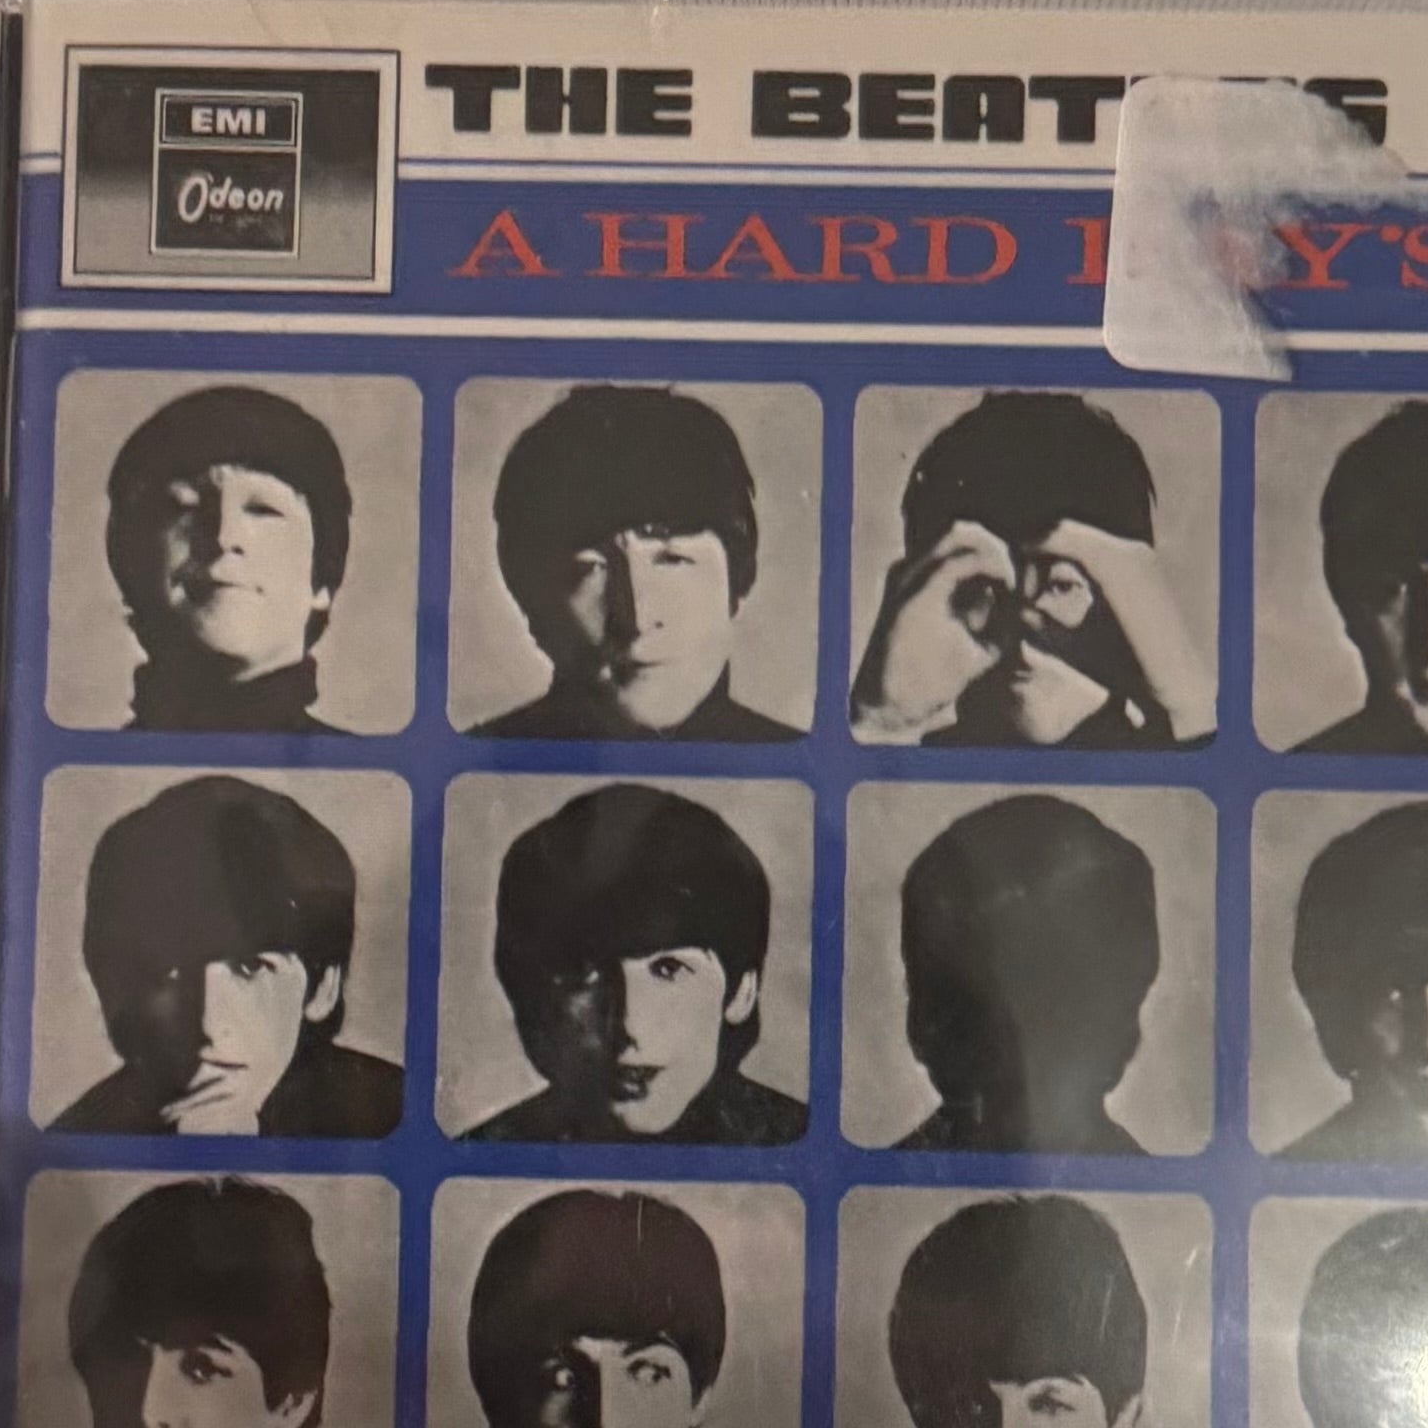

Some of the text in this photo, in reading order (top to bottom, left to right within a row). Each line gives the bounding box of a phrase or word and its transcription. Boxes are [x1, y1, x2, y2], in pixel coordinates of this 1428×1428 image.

[190, 104, 267, 136] EMI
[424, 63, 1389, 146] THE BEATS
[176, 170, 284, 223] Odeon
[445, 207, 559, 278] A
[582, 210, 1018, 285] HARD
